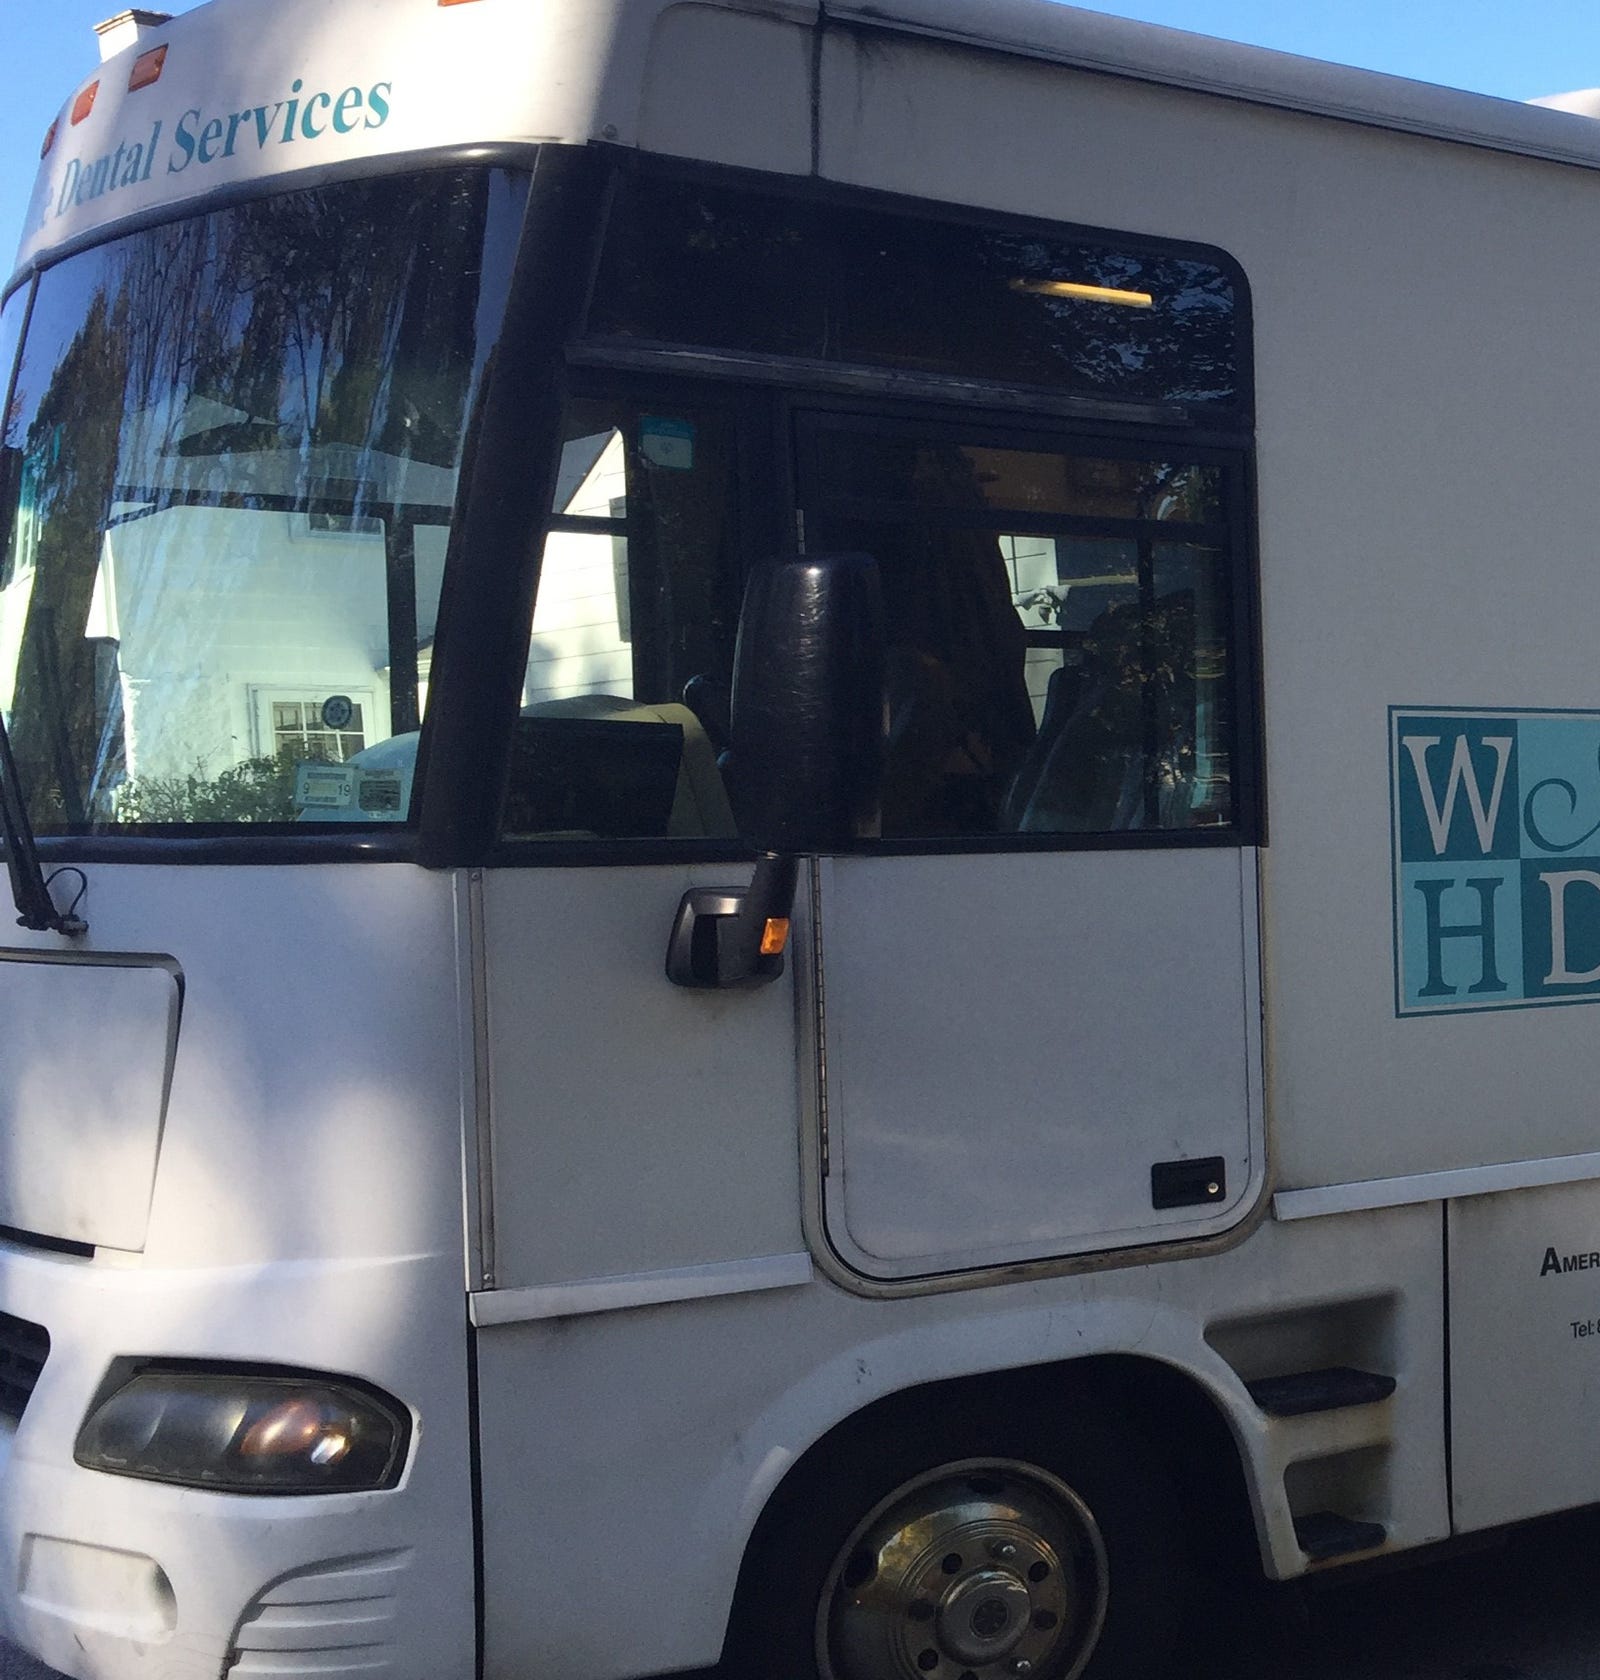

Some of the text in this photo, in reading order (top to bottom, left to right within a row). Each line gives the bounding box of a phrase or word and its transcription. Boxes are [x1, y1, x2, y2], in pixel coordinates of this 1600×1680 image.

[57, 120, 162, 217] Dental
[167, 79, 392, 176] Services
[338, 783, 352, 796] 19
[1402, 734, 1513, 855] W
[1414, 877, 1508, 997] H
